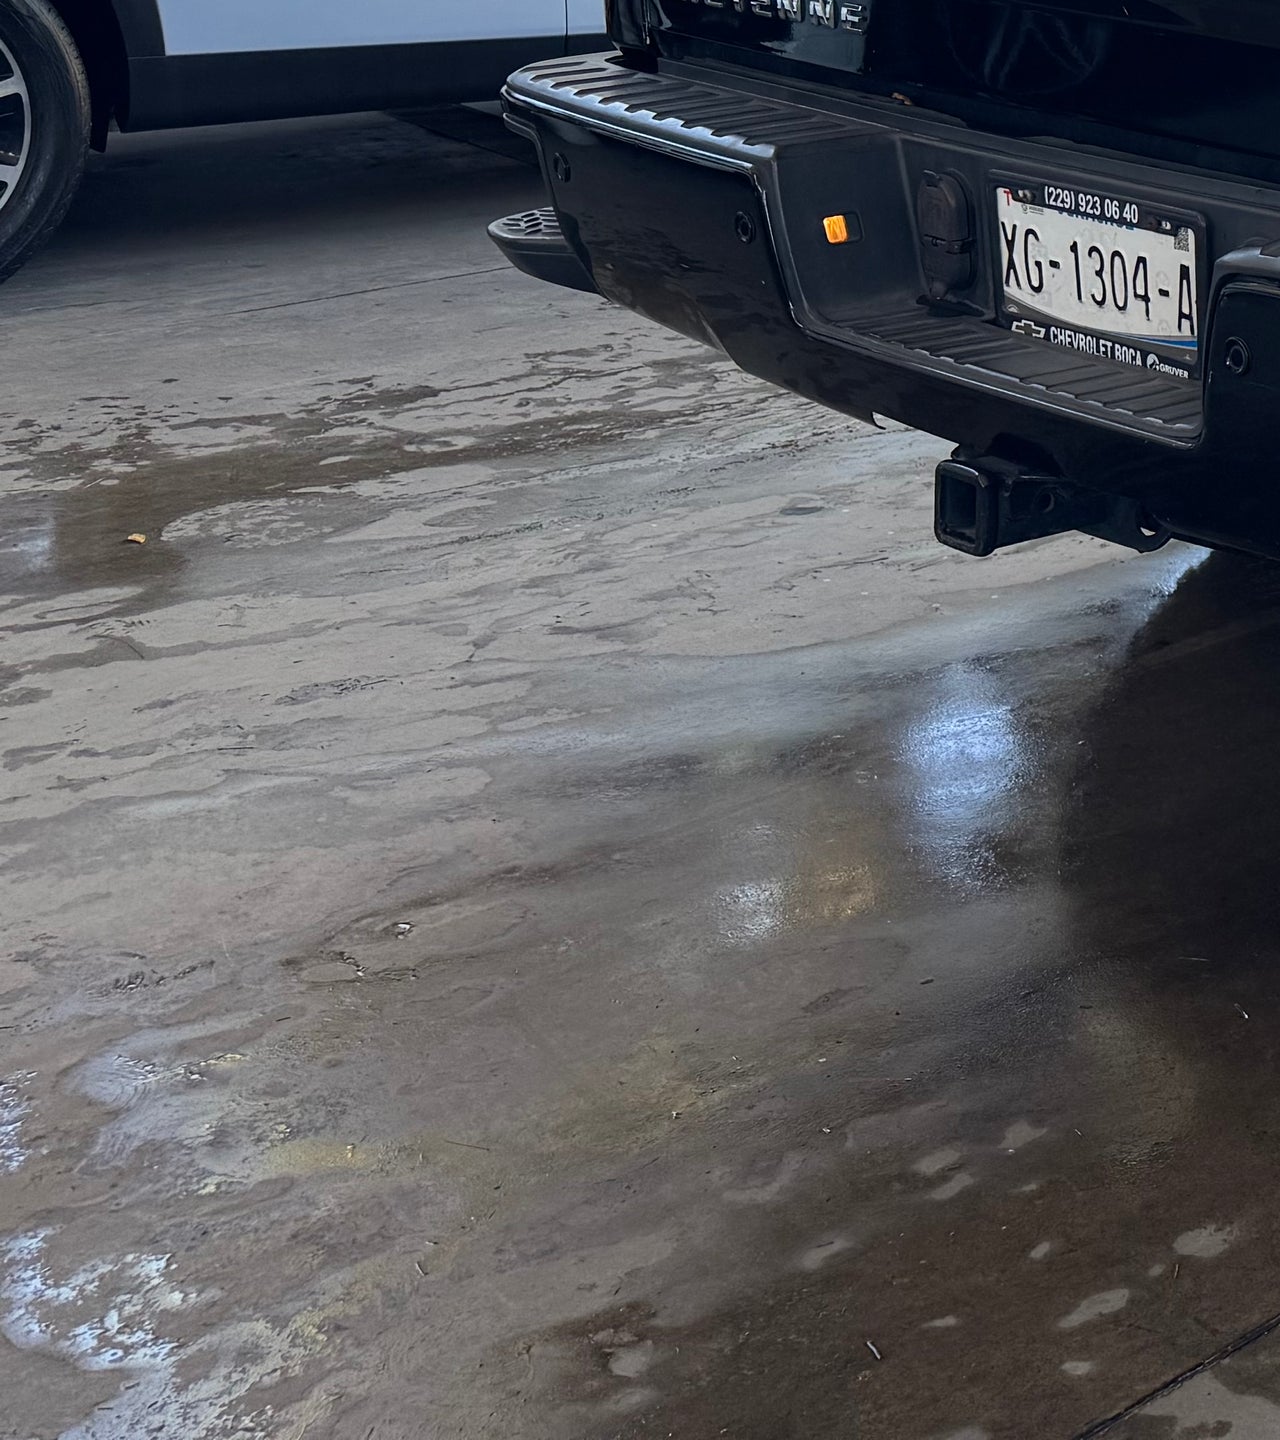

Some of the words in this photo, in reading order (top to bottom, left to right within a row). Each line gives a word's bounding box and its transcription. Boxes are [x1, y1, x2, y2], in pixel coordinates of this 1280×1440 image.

[1044, 185, 1075, 211] (229)
[1078, 193, 1101, 216] 923
[1104, 198, 1120, 220] 06
[1122, 202, 1139, 224] 40
[1001, 220, 1196, 335] XG-1304-A
[1050, 326, 1113, 359] CHEVROLET
[1115, 343, 1142, 367] BOCA
[1160, 362, 1189, 379] GRUVER
